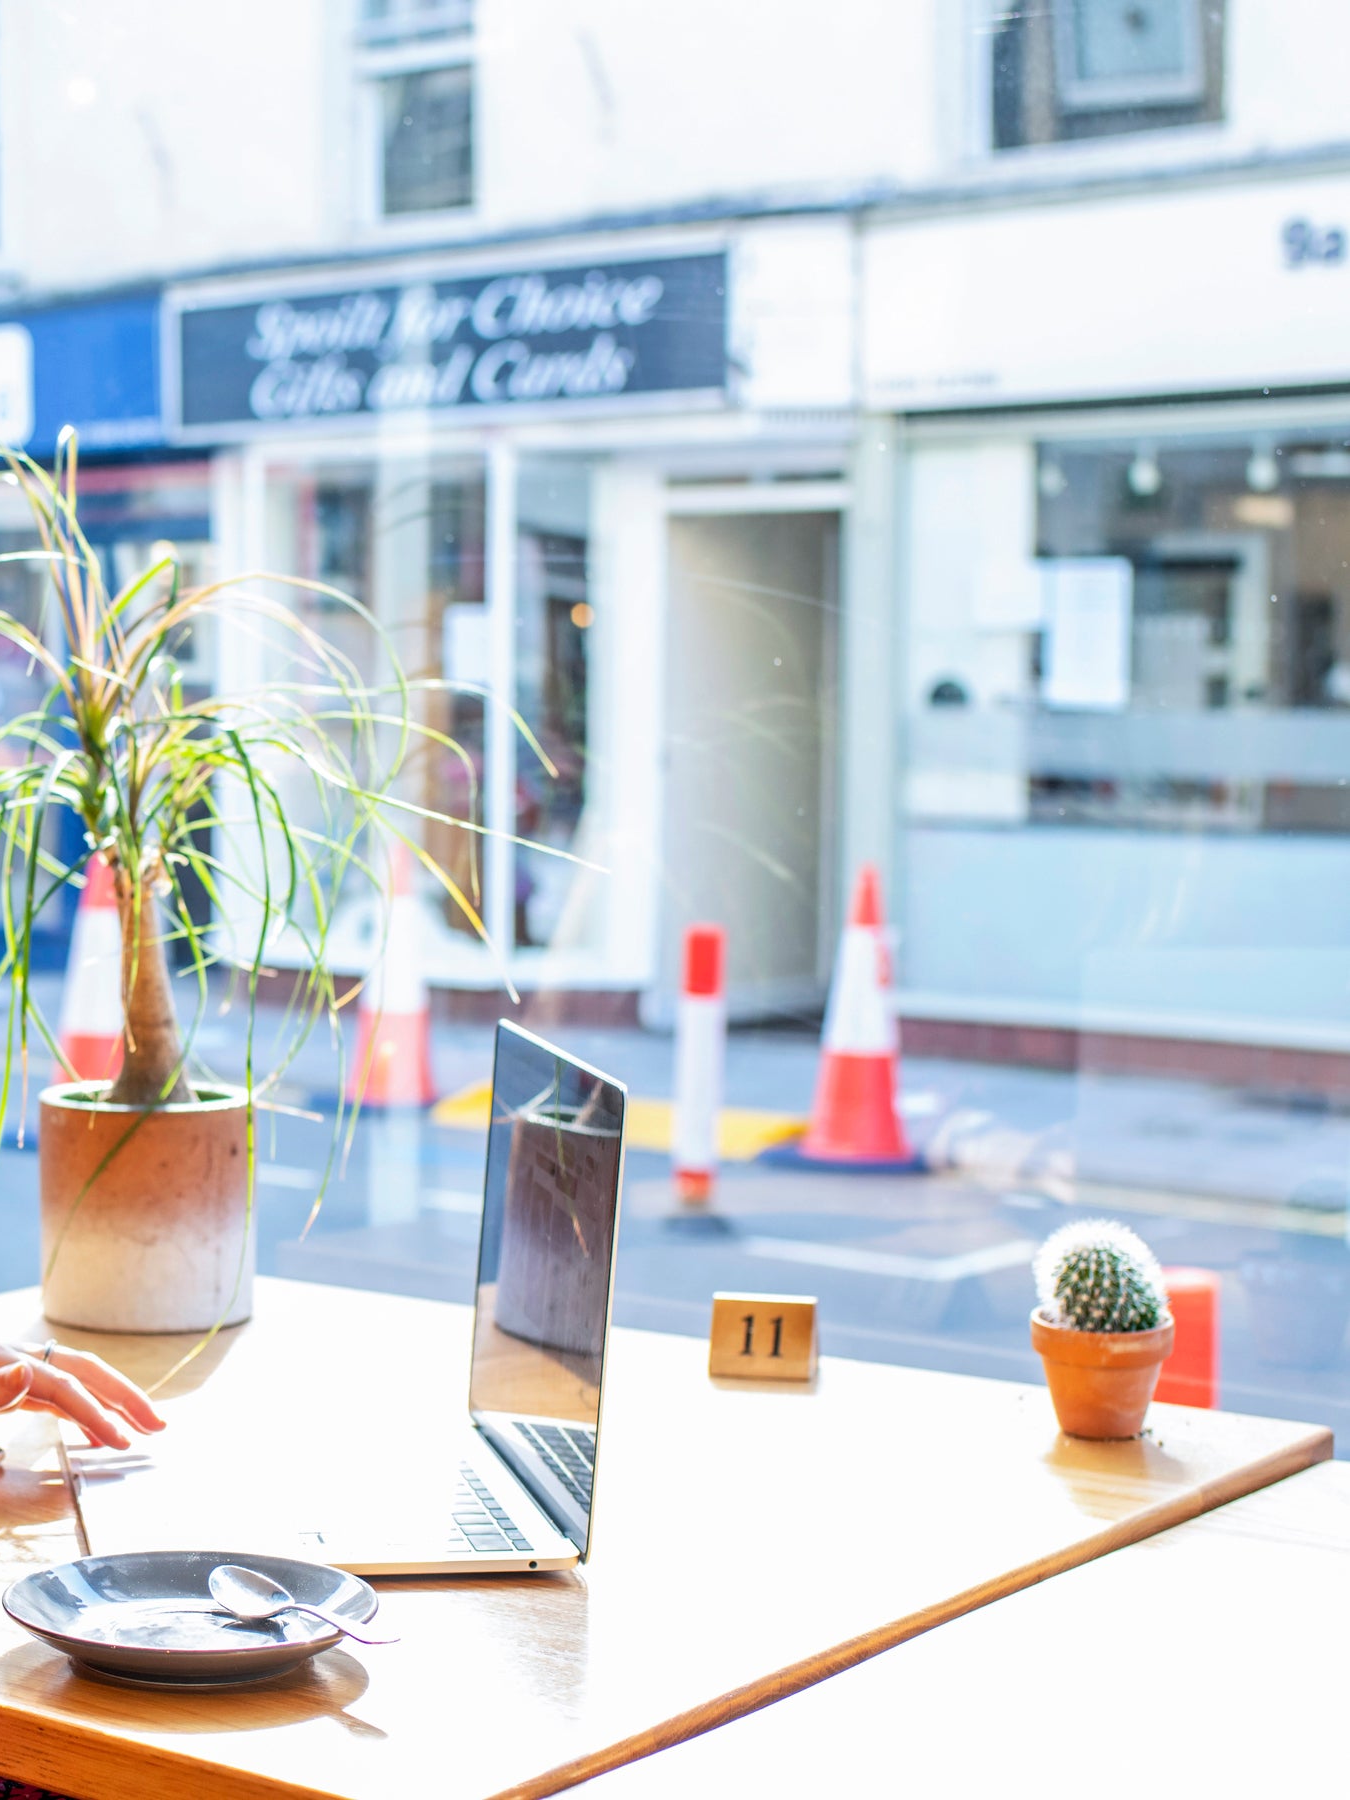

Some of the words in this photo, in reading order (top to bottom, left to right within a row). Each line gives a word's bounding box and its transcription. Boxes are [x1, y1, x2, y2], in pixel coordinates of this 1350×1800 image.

[247, 293, 388, 360] Spoilt
[376, 284, 474, 360] for
[471, 270, 663, 339] Choice
[250, 352, 366, 420] Gifts
[366, 344, 474, 411] and
[470, 333, 634, 405] Cards
[740, 1313, 783, 1358] 11
